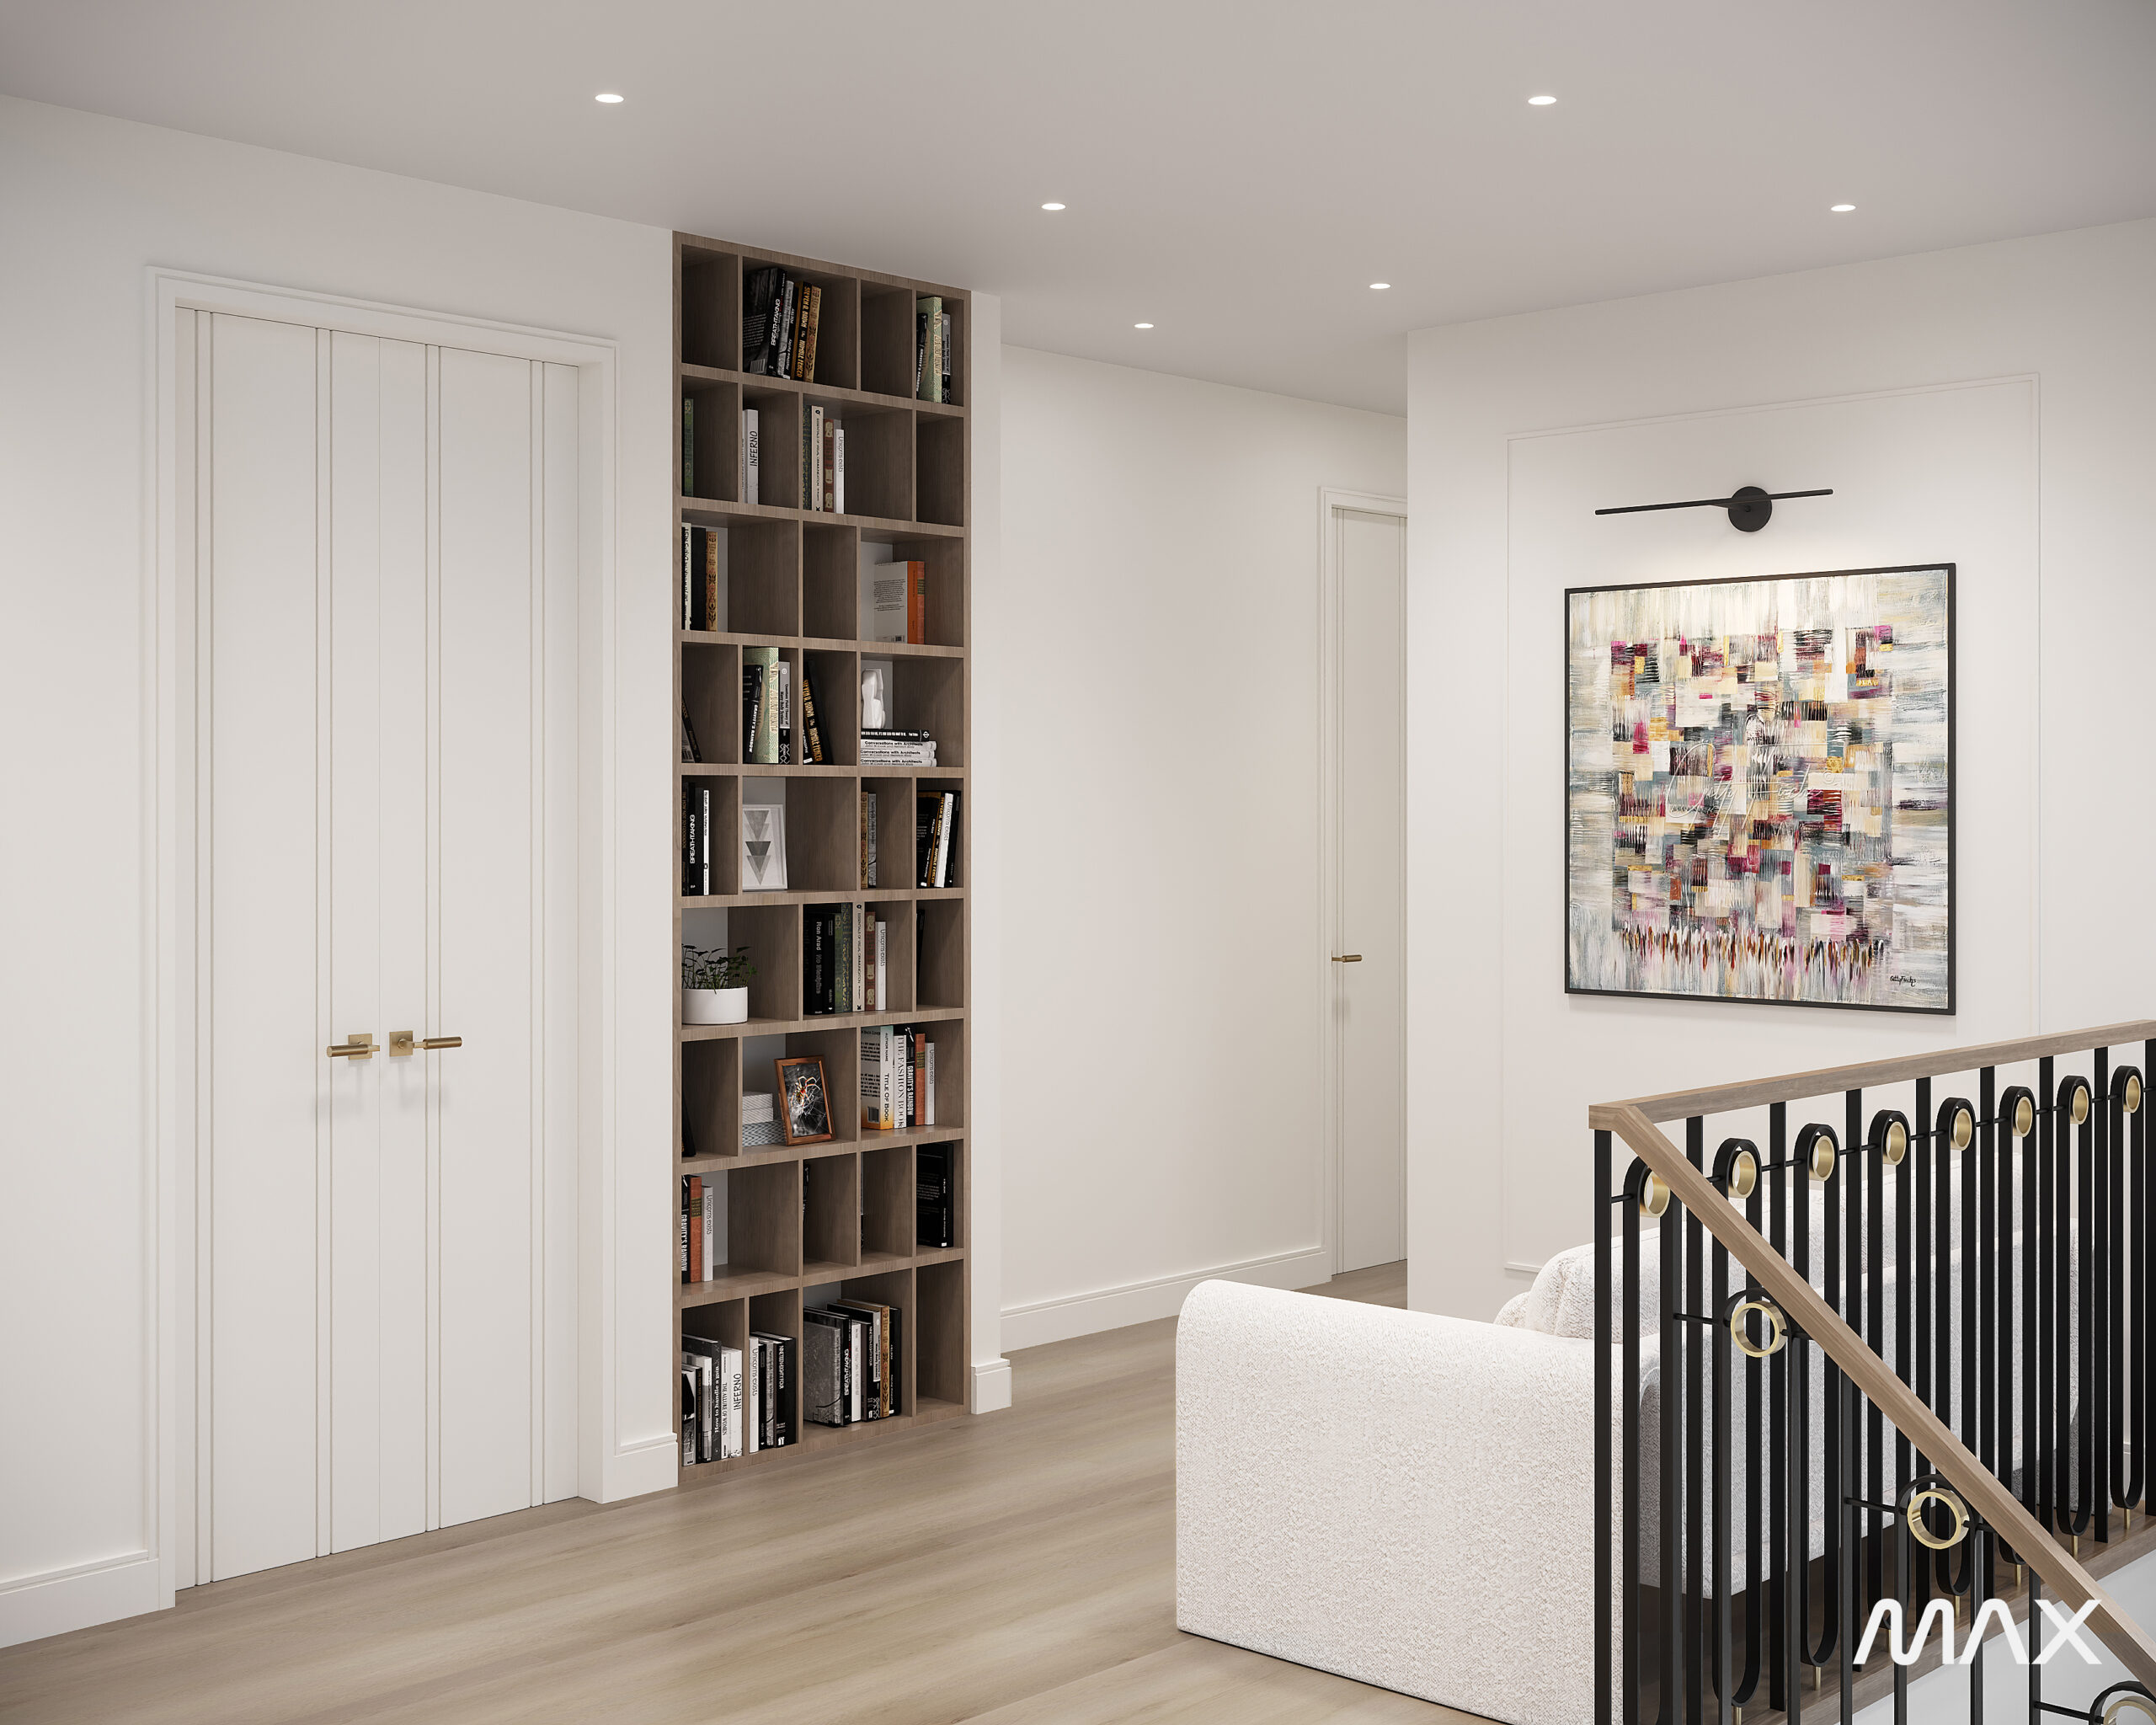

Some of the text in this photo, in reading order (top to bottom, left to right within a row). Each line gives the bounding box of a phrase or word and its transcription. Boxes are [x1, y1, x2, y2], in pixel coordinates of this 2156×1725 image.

[771, 298, 781, 346] BREATHTAKING
[750, 430, 758, 467] INFERNO
[734, 1373, 742, 1410] INFERNO
